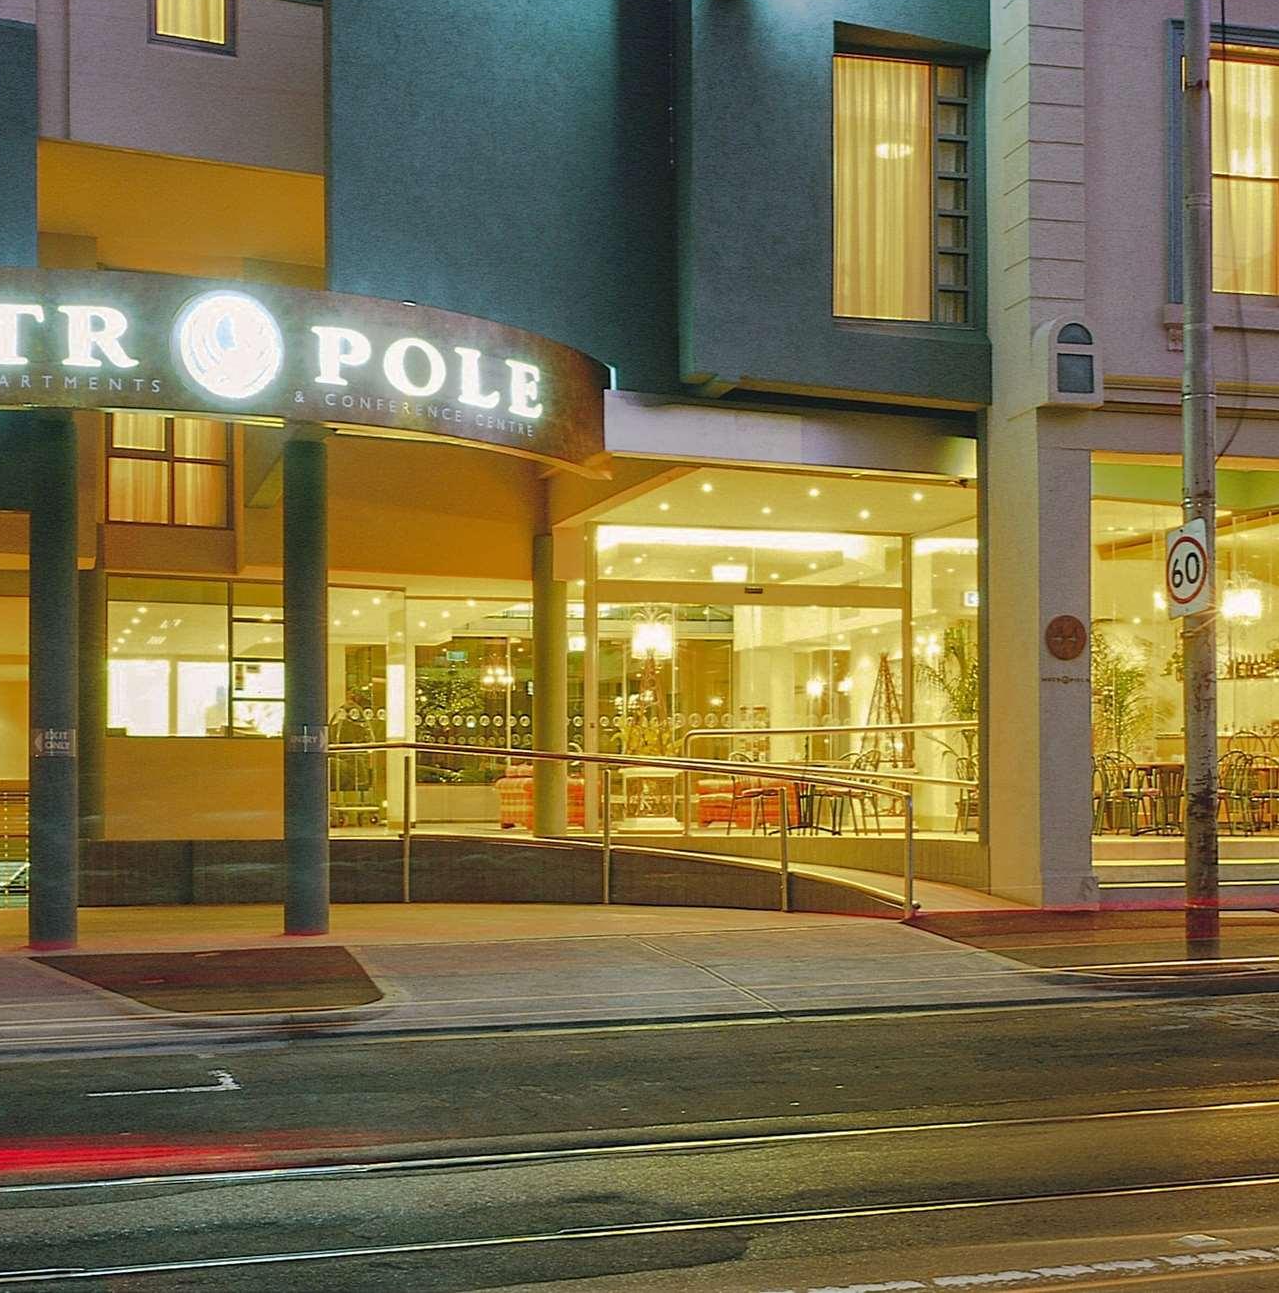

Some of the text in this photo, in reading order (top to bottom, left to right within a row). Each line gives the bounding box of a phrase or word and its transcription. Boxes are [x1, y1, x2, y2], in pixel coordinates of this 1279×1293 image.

[294, 391, 305, 404] &
[325, 392, 463, 424] CONFERENCE
[475, 413, 535, 438] CENTRE
[1171, 551, 1200, 589] 60
